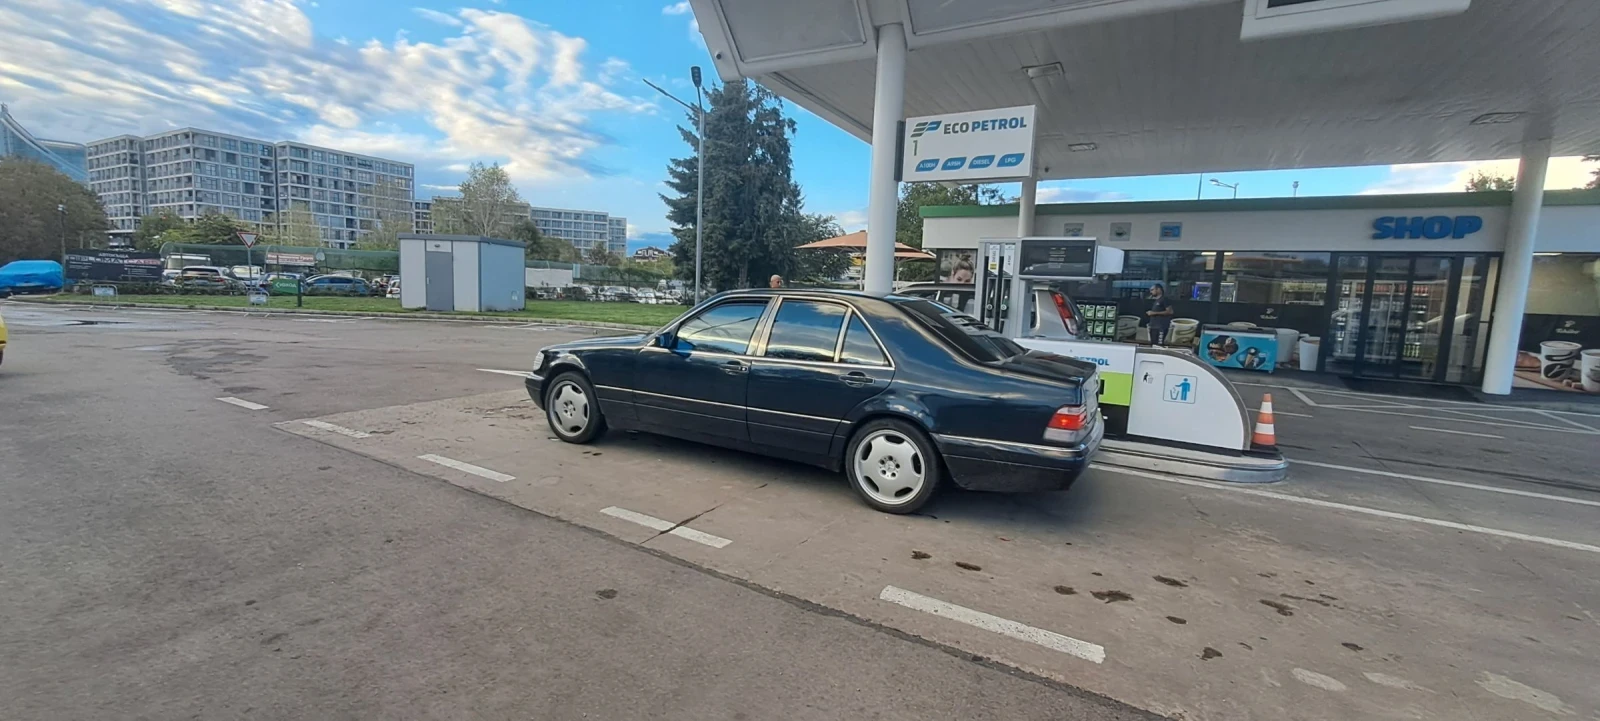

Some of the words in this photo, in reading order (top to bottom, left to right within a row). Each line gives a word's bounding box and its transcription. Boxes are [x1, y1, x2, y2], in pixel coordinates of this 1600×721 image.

[913, 140, 918, 156] 1
[1371, 215, 1482, 239] SHOP
[1074, 356, 1110, 366] ROL
